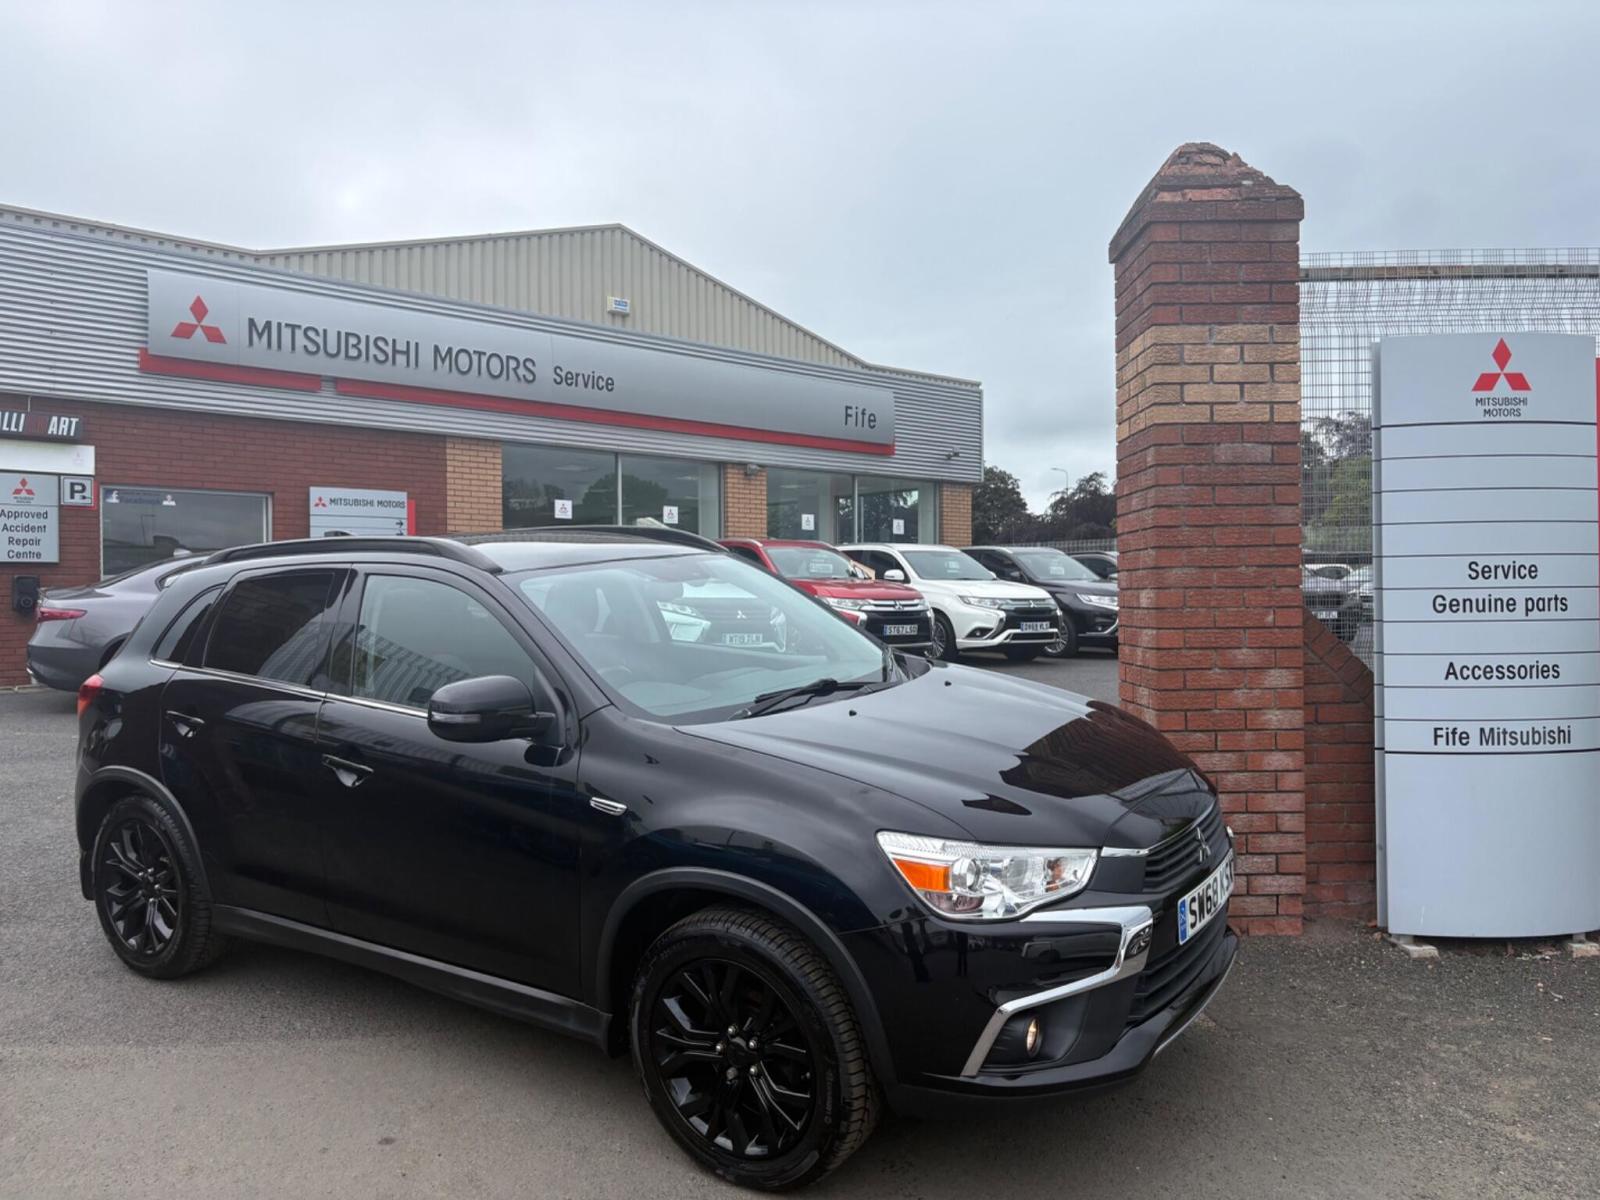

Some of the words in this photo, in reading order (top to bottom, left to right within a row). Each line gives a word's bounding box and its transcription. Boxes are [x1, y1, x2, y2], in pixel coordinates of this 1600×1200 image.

[247, 317, 420, 369] MITSUBISHI
[433, 344, 537, 384] MOTORS
[553, 365, 615, 392] Service
[1475, 397, 1528, 407] MITSUBISHI
[845, 405, 877, 430] Fife
[1483, 408, 1522, 417] MOTORS
[0, 411, 26, 433] LLI
[48, 416, 80, 437] ART
[69, 482, 87, 500] P
[329, 497, 375, 508] MITSUBISHI
[376, 500, 406, 509] MOTORS
[0, 509, 49, 520] Approved
[1, 523, 47, 534] Accident
[8, 536, 42, 547] Repair
[7, 549, 42, 560] Centre
[1468, 560, 1539, 580] Service
[1432, 593, 1517, 614] Genuine
[1524, 594, 1569, 617] parts
[1444, 660, 1561, 681] Accessories
[1433, 726, 1470, 746] Fife
[1479, 725, 1572, 746] Mitsubishi
